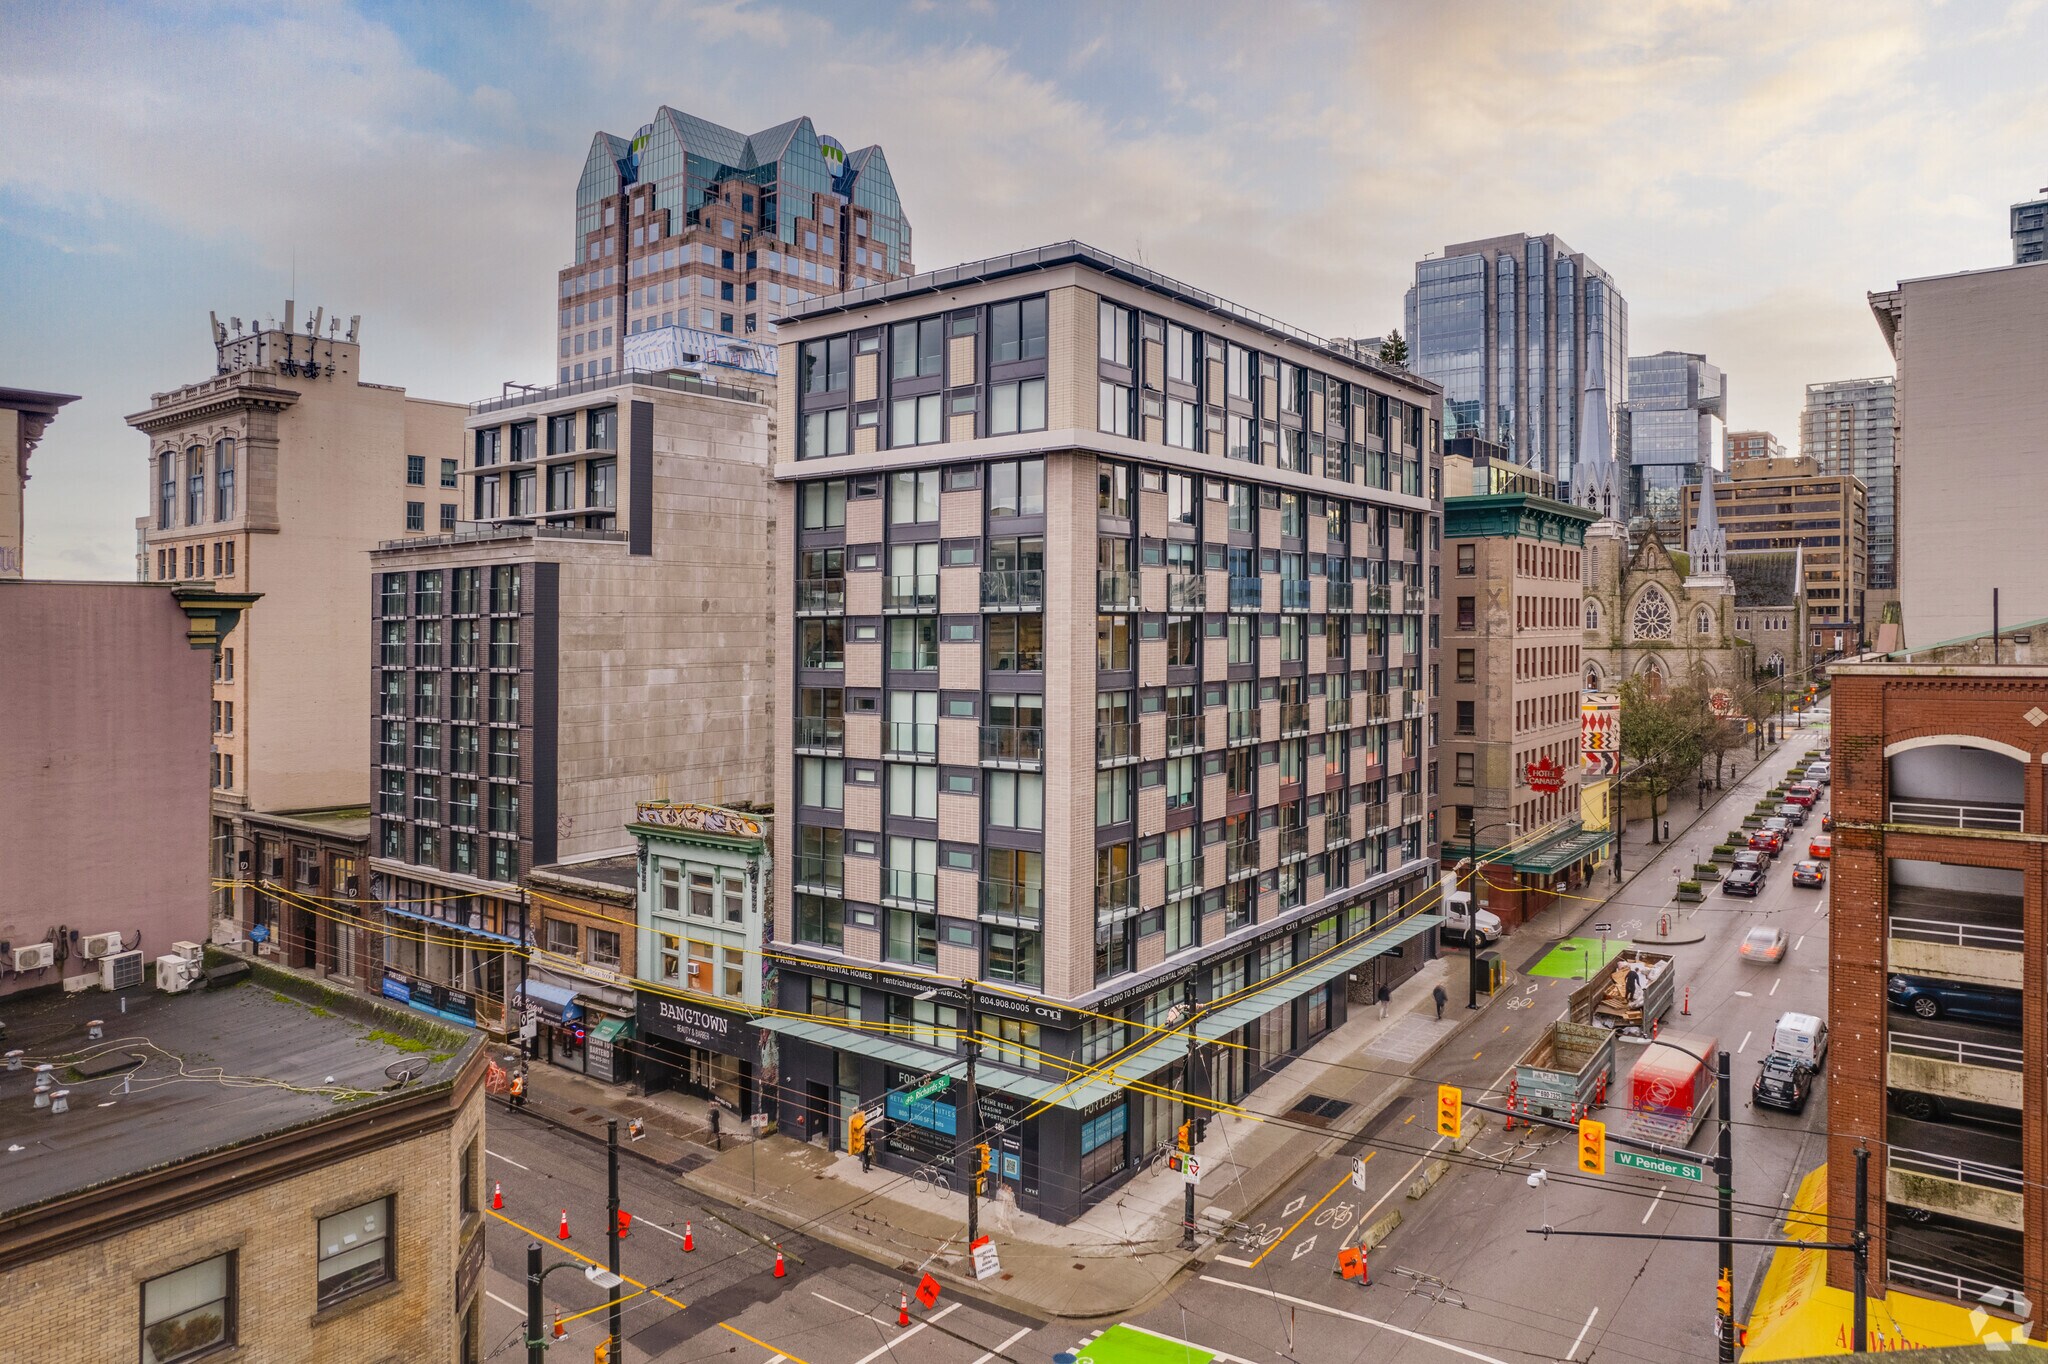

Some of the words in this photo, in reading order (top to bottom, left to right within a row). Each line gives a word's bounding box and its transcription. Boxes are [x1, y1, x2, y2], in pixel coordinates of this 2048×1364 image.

[801, 960, 826, 971] MODERN
[826, 965, 850, 976] RENTAL
[850, 969, 873, 981] HOMES
[1103, 993, 1124, 1008] STUDIO
[1123, 989, 1132, 1000] TO
[1131, 988, 1136, 997] 3
[1135, 978, 1160, 994] BEDROOM
[1159, 971, 1178, 984] RENTAL
[980, 996, 1030, 1013] 604.908.0005
[659, 1001, 728, 1034] BANGTOWN
[1035, 1007, 1062, 1021] onni
[676, 1024, 691, 1036] BEAUTY
[691, 1028, 695, 1037] &
[695, 1029, 710, 1040] BARBER
[915, 1084, 938, 1100] Richards
[938, 1079, 946, 1089] St.
[910, 1102, 956, 1119] PPORTUNITIES
[980, 1104, 1002, 1115] LEASING
[981, 1097, 997, 1107] PRIME
[997, 1101, 1015, 1112] RETAIL
[1084, 1100, 1099, 1117] FOR
[1100, 1089, 1122, 1109] LEASE
[979, 1112, 1020, 1126] OPPORTUNITIES
[889, 1140, 915, 1153] ONNI.COM
[1620, 1153, 1632, 1164] W
[1636, 1157, 1678, 1174] Pender
[1682, 1166, 1696, 1178] St
